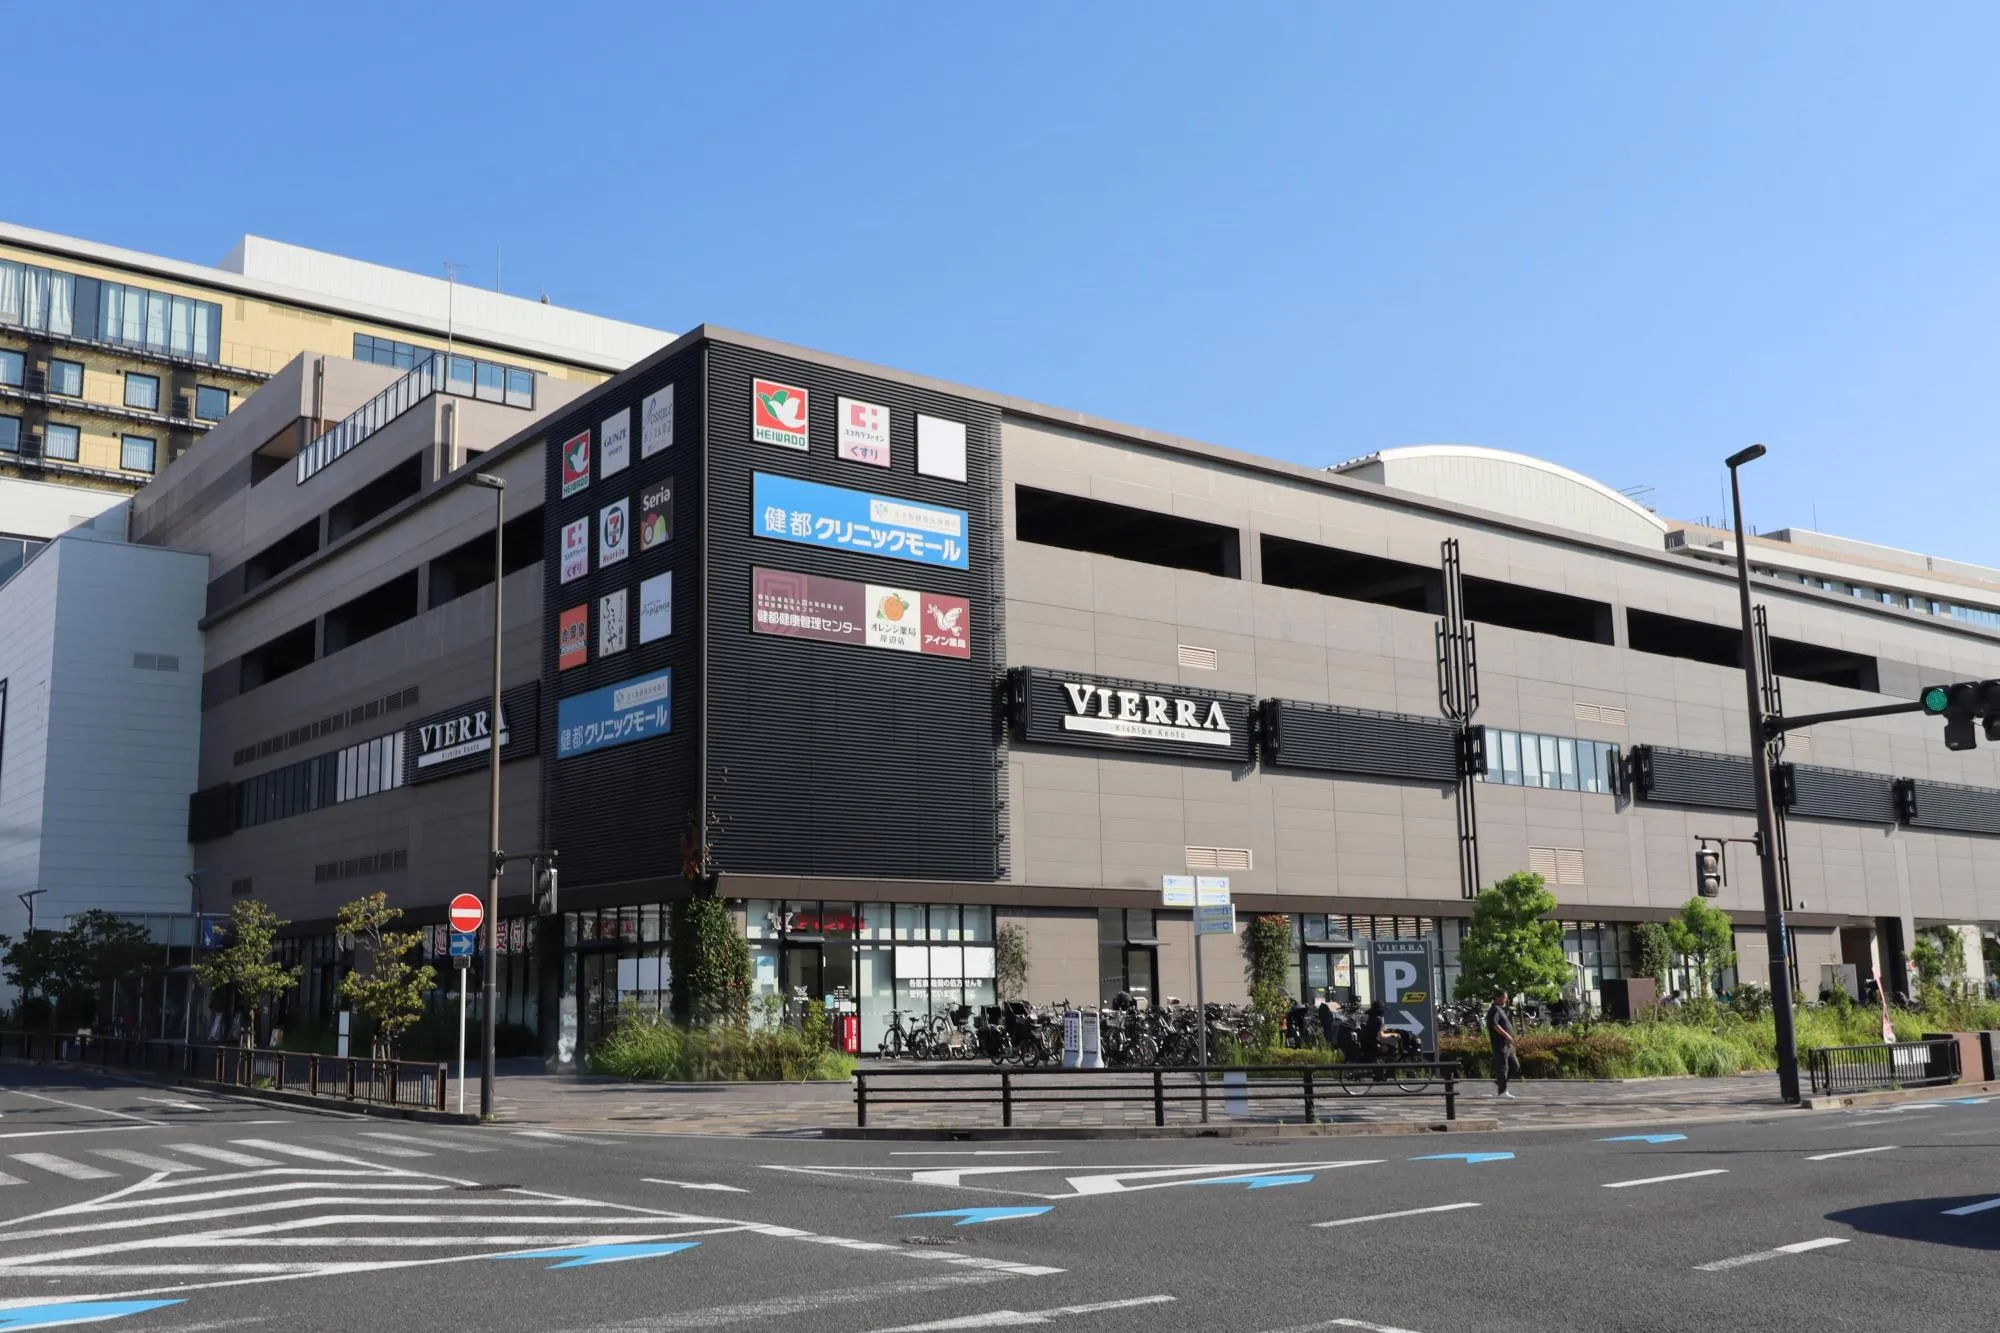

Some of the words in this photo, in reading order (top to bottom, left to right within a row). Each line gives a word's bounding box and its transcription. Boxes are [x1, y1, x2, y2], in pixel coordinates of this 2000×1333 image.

[603, 427, 628, 448] GUNZE
[756, 428, 806, 447] HEIWADO
[850, 445, 879, 460] くすり
[563, 475, 589, 496] HEIWADO
[642, 486, 671, 512] Seria
[763, 505, 961, 562] 健都クリニックモール
[566, 563, 583, 577] くすり
[871, 622, 917, 637] オレンジ薬局
[924, 634, 966, 649] アイン薬局
[1063, 683, 1231, 731] VIERRA
[560, 704, 668, 752] 健都クリニックモール
[1376, 943, 1425, 952] VIERRA
[1383, 960, 1418, 1004] P
